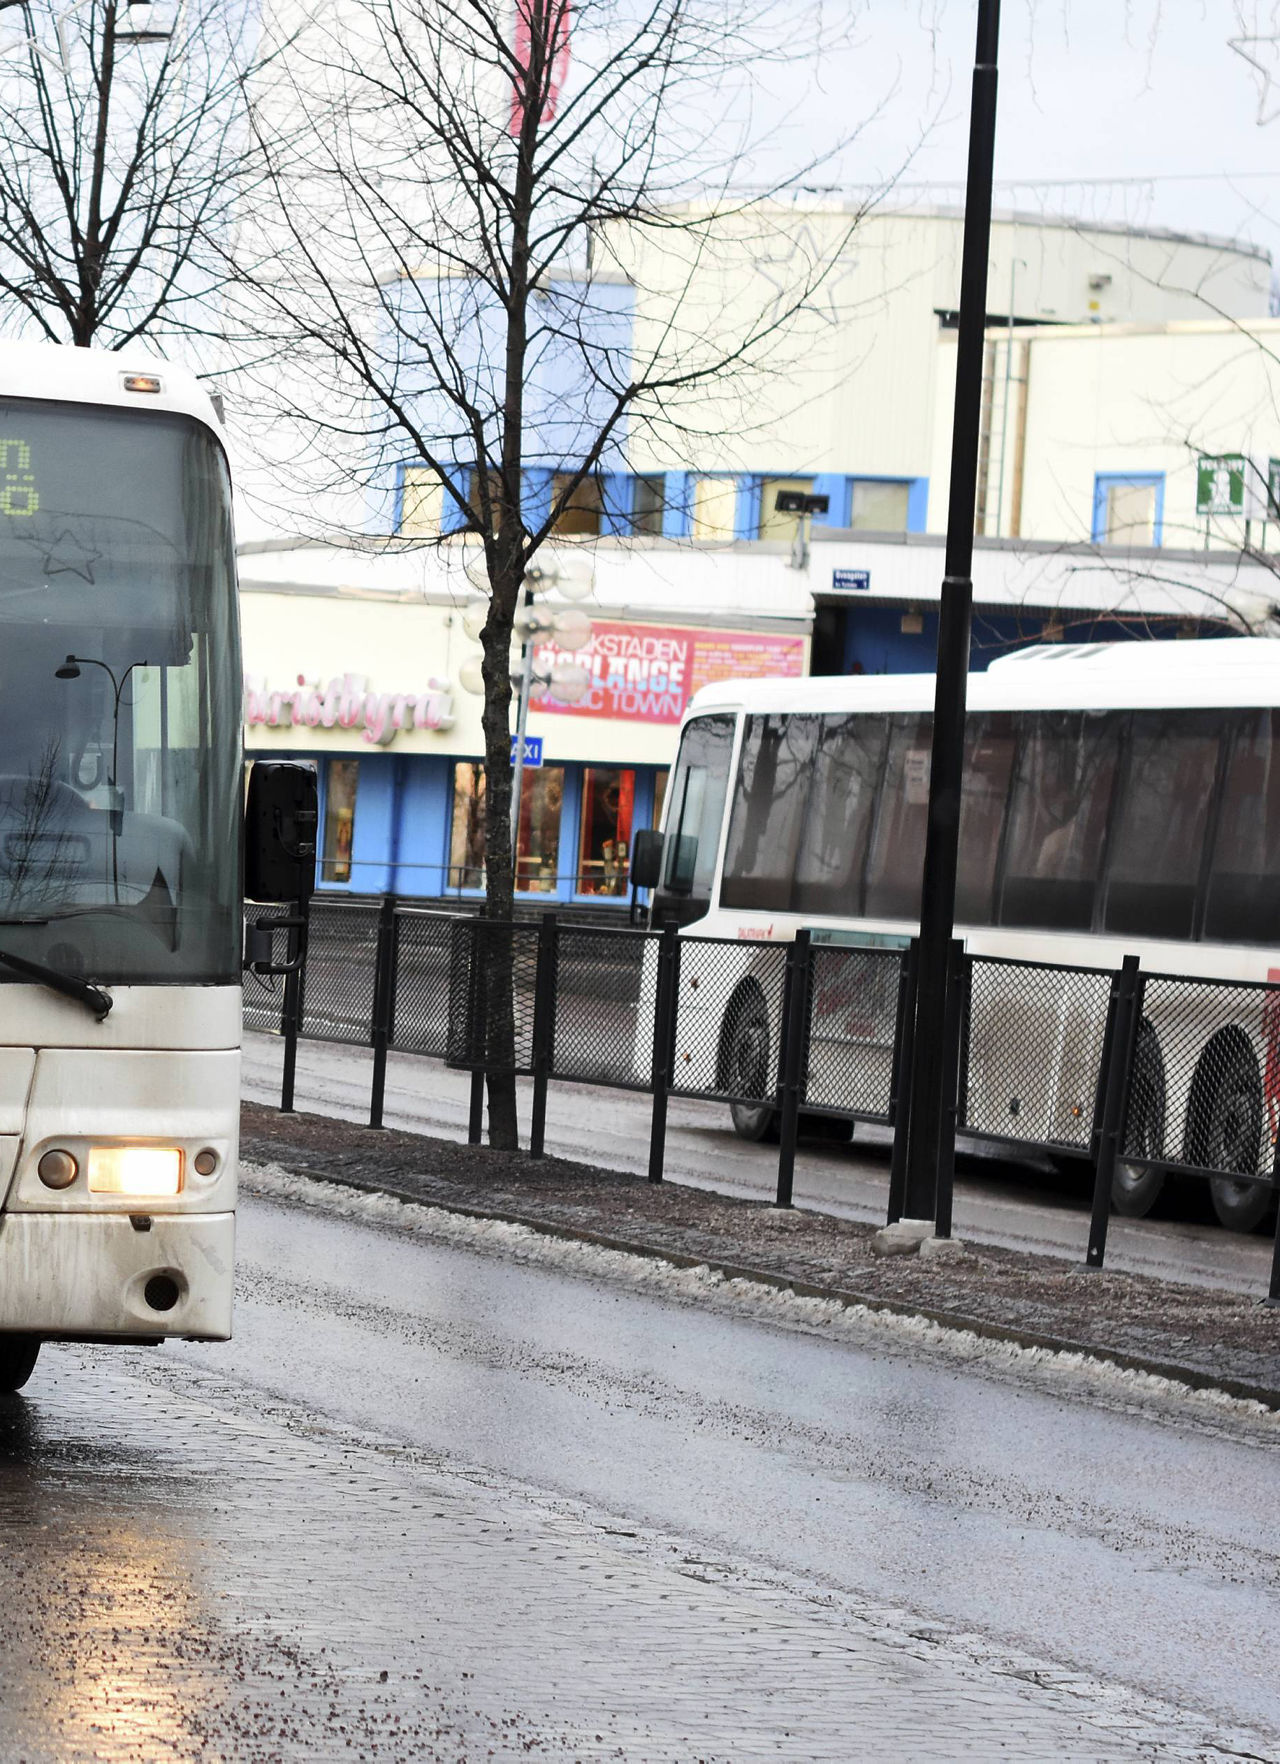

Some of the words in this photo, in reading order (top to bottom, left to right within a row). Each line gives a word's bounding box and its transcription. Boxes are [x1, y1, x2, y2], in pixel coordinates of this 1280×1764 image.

[538, 633, 687, 661] KSTADEN
[246, 673, 452, 744] uristbyrå
[611, 690, 683, 717] TOWN
[510, 743, 539, 759] AXI
